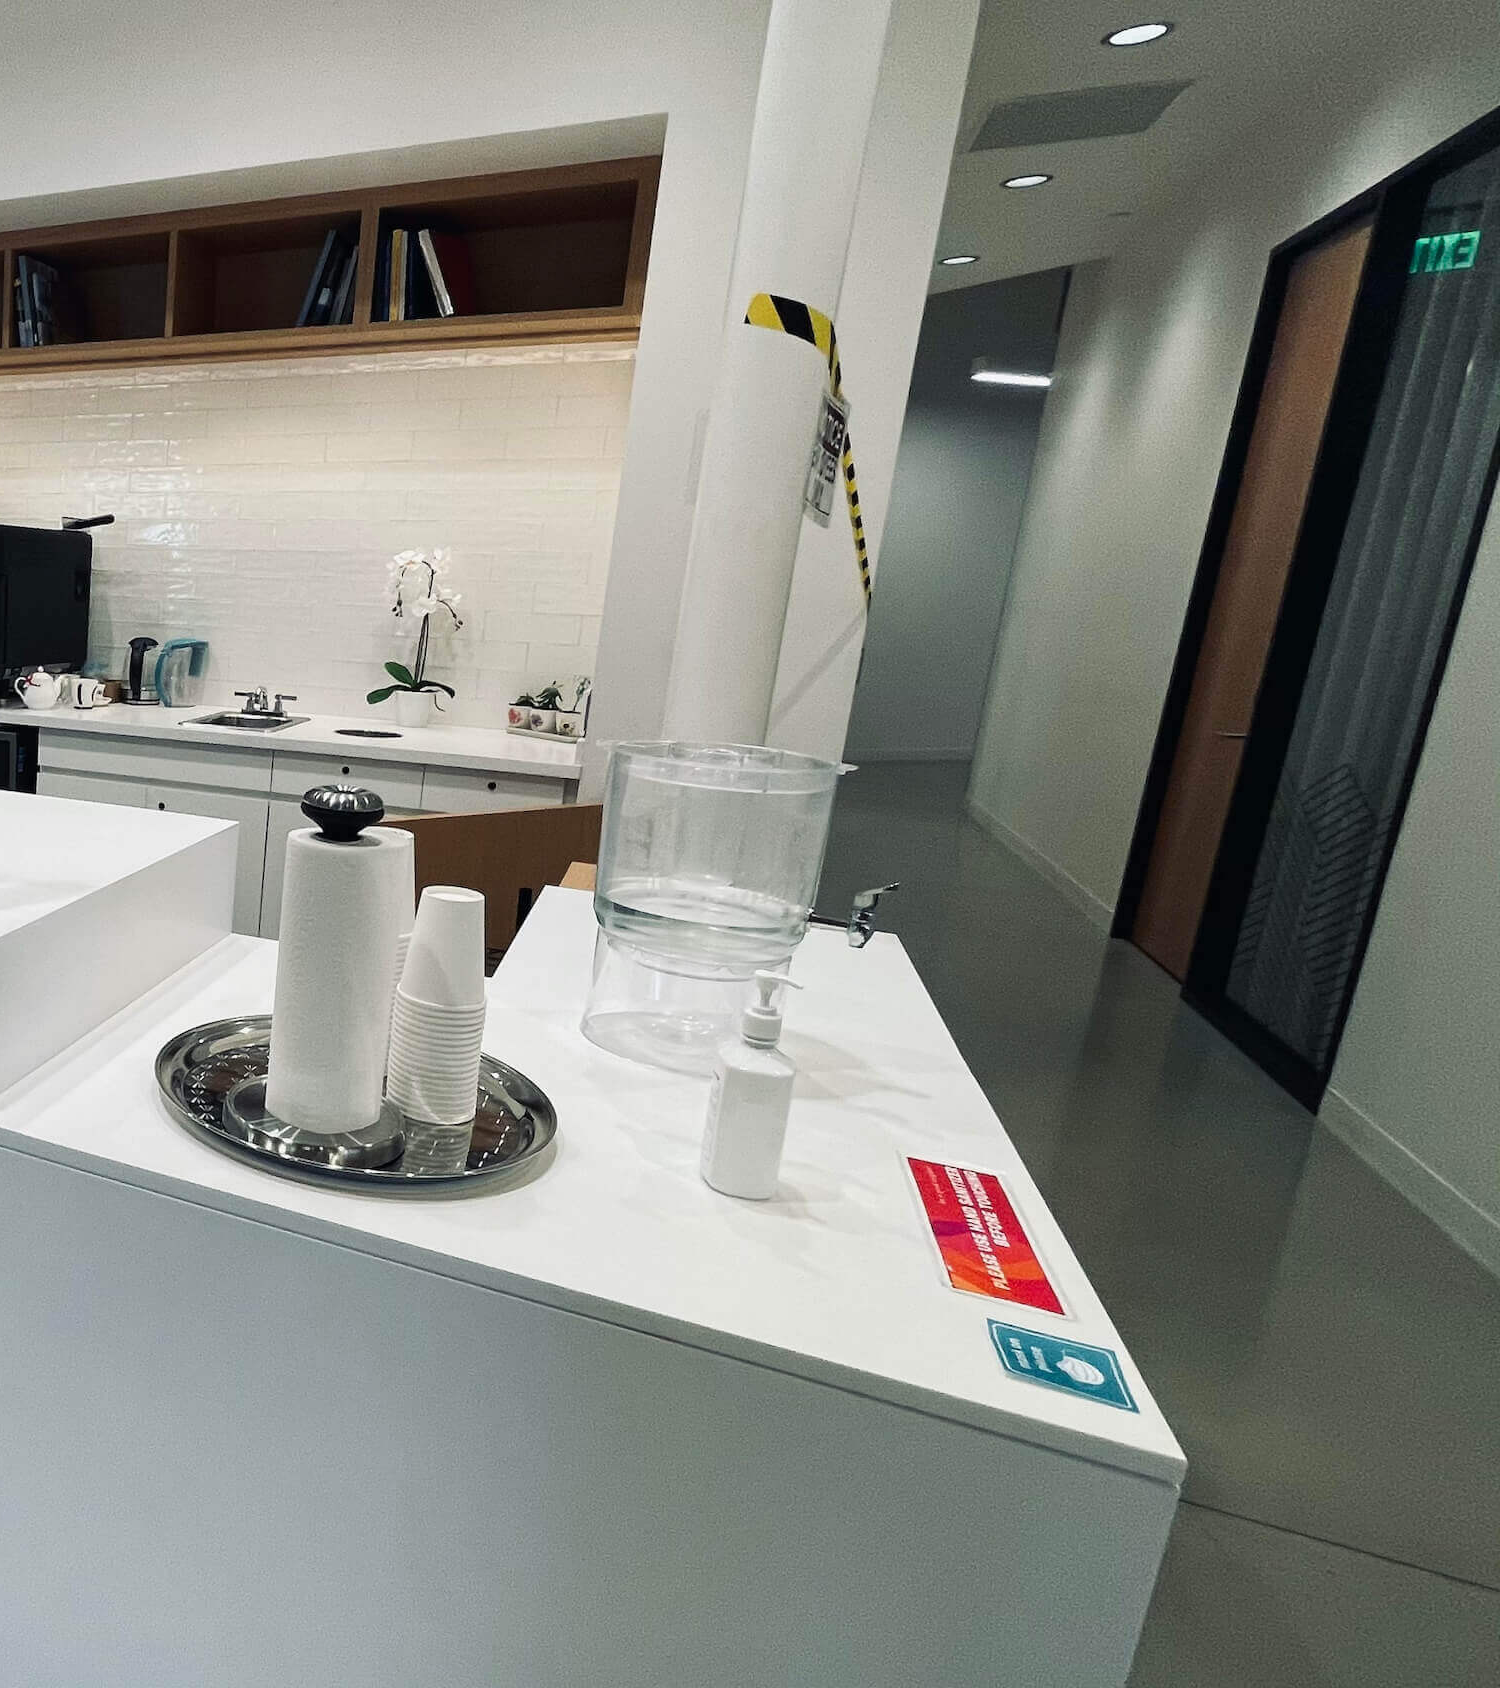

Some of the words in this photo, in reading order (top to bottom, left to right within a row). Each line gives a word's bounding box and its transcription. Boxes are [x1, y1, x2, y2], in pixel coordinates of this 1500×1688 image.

[944, 1166, 974, 1206] SANITIZER
[963, 1171, 994, 1209] TOUCHING
[961, 1206, 986, 1233] HAND
[981, 1210, 1011, 1248] BEFORE
[971, 1231, 993, 1252] USE
[980, 1251, 1011, 1290] PLEASE
